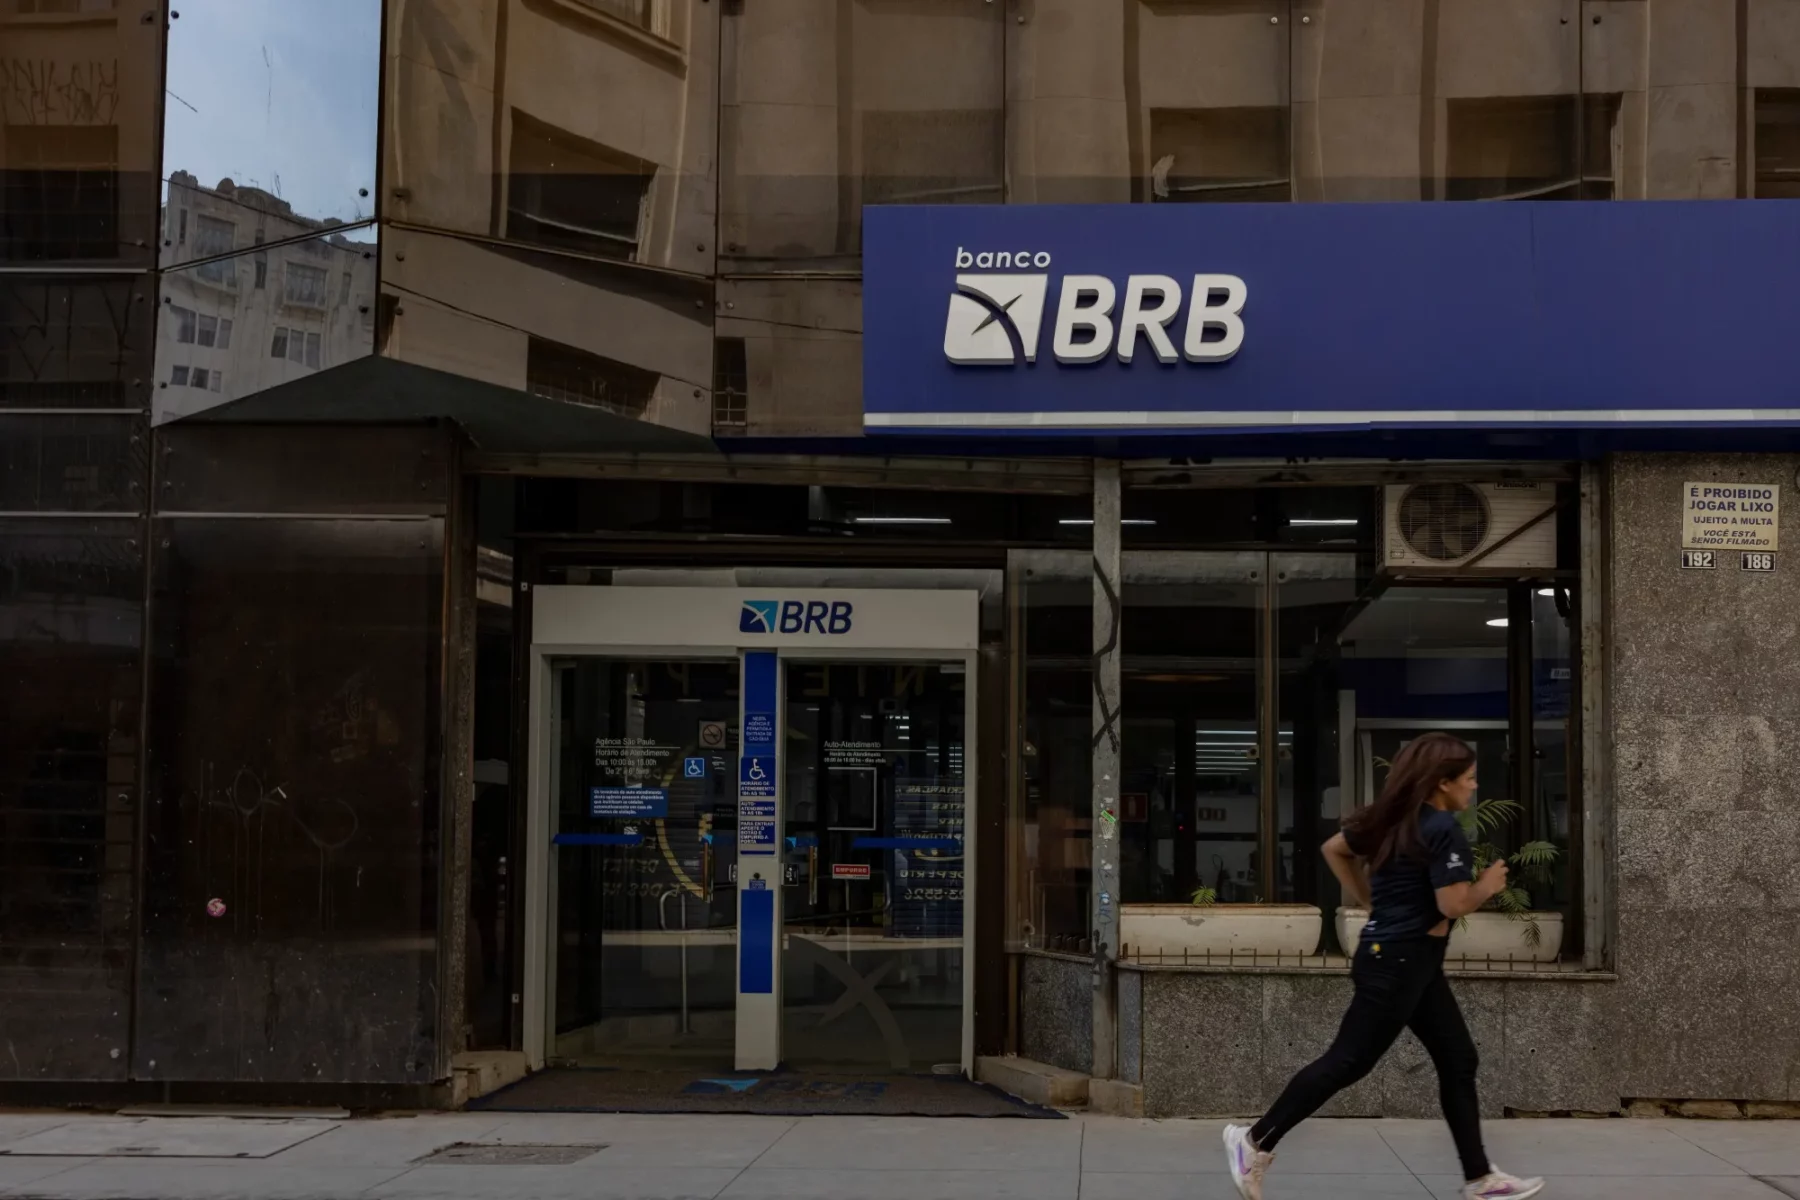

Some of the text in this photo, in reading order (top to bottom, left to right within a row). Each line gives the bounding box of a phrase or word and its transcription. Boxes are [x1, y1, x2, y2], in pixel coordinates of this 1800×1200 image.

[955, 246, 1052, 269] banco
[1053, 273, 1248, 365] BRB
[1690, 485, 1772, 500] É PROIBIDO
[1689, 500, 1774, 513] JOGAR LIXO
[1731, 517, 1738, 525] A
[1740, 517, 1773, 526] MULTA
[1703, 529, 1757, 538] VOCÊ ESTÁ
[1691, 537, 1770, 546] SENDO FILMADO
[1686, 552, 1712, 567] 192
[1746, 554, 1771, 569] 186
[779, 600, 853, 635] BRB
[595, 737, 656, 747] Agência São Paulo
[823, 740, 882, 748] Auto-Atendimento
[595, 749, 670, 757] Horário de Atendimento
[610, 758, 627, 766] 10:00
[605, 767, 615, 775] De
